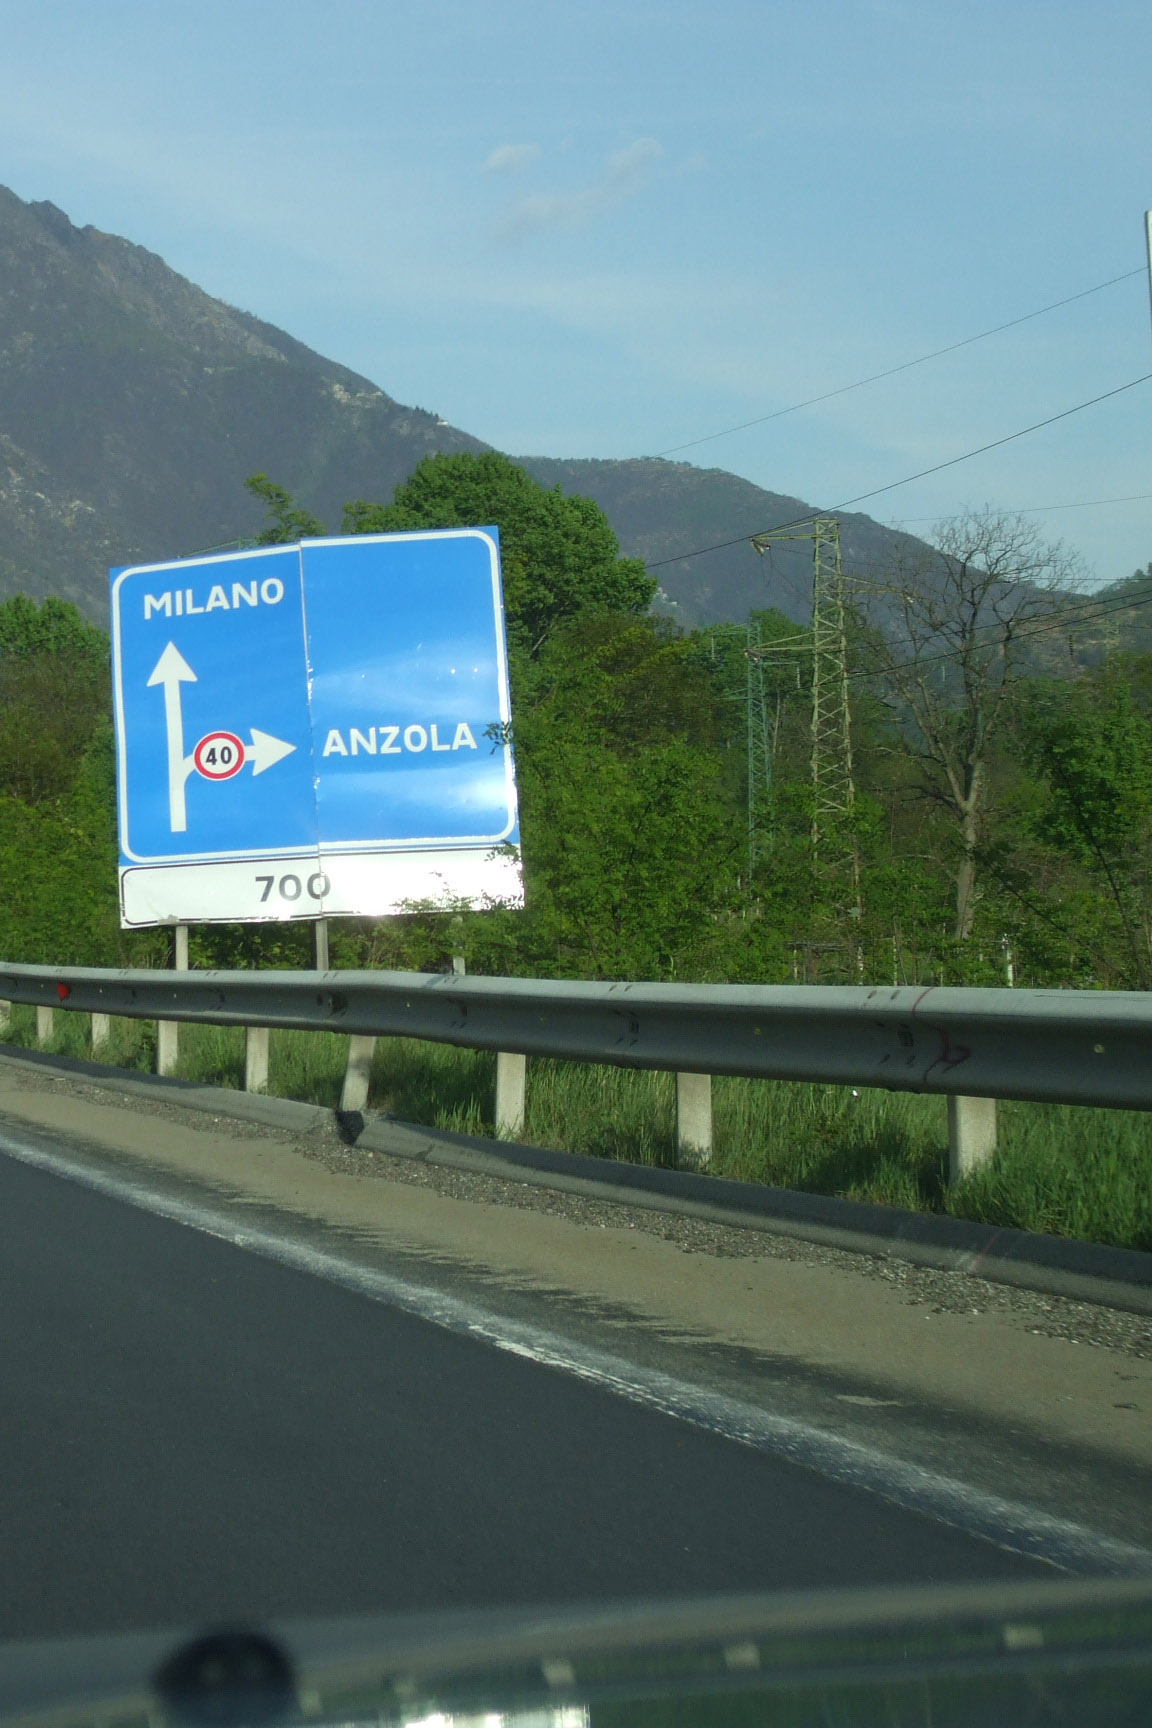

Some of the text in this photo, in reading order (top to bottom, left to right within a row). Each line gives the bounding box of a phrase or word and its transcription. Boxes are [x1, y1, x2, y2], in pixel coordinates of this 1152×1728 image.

[144, 578, 284, 619] MILANO
[206, 746, 232, 765] 40
[322, 722, 477, 757] ANZOLA
[255, 872, 331, 902] 700
